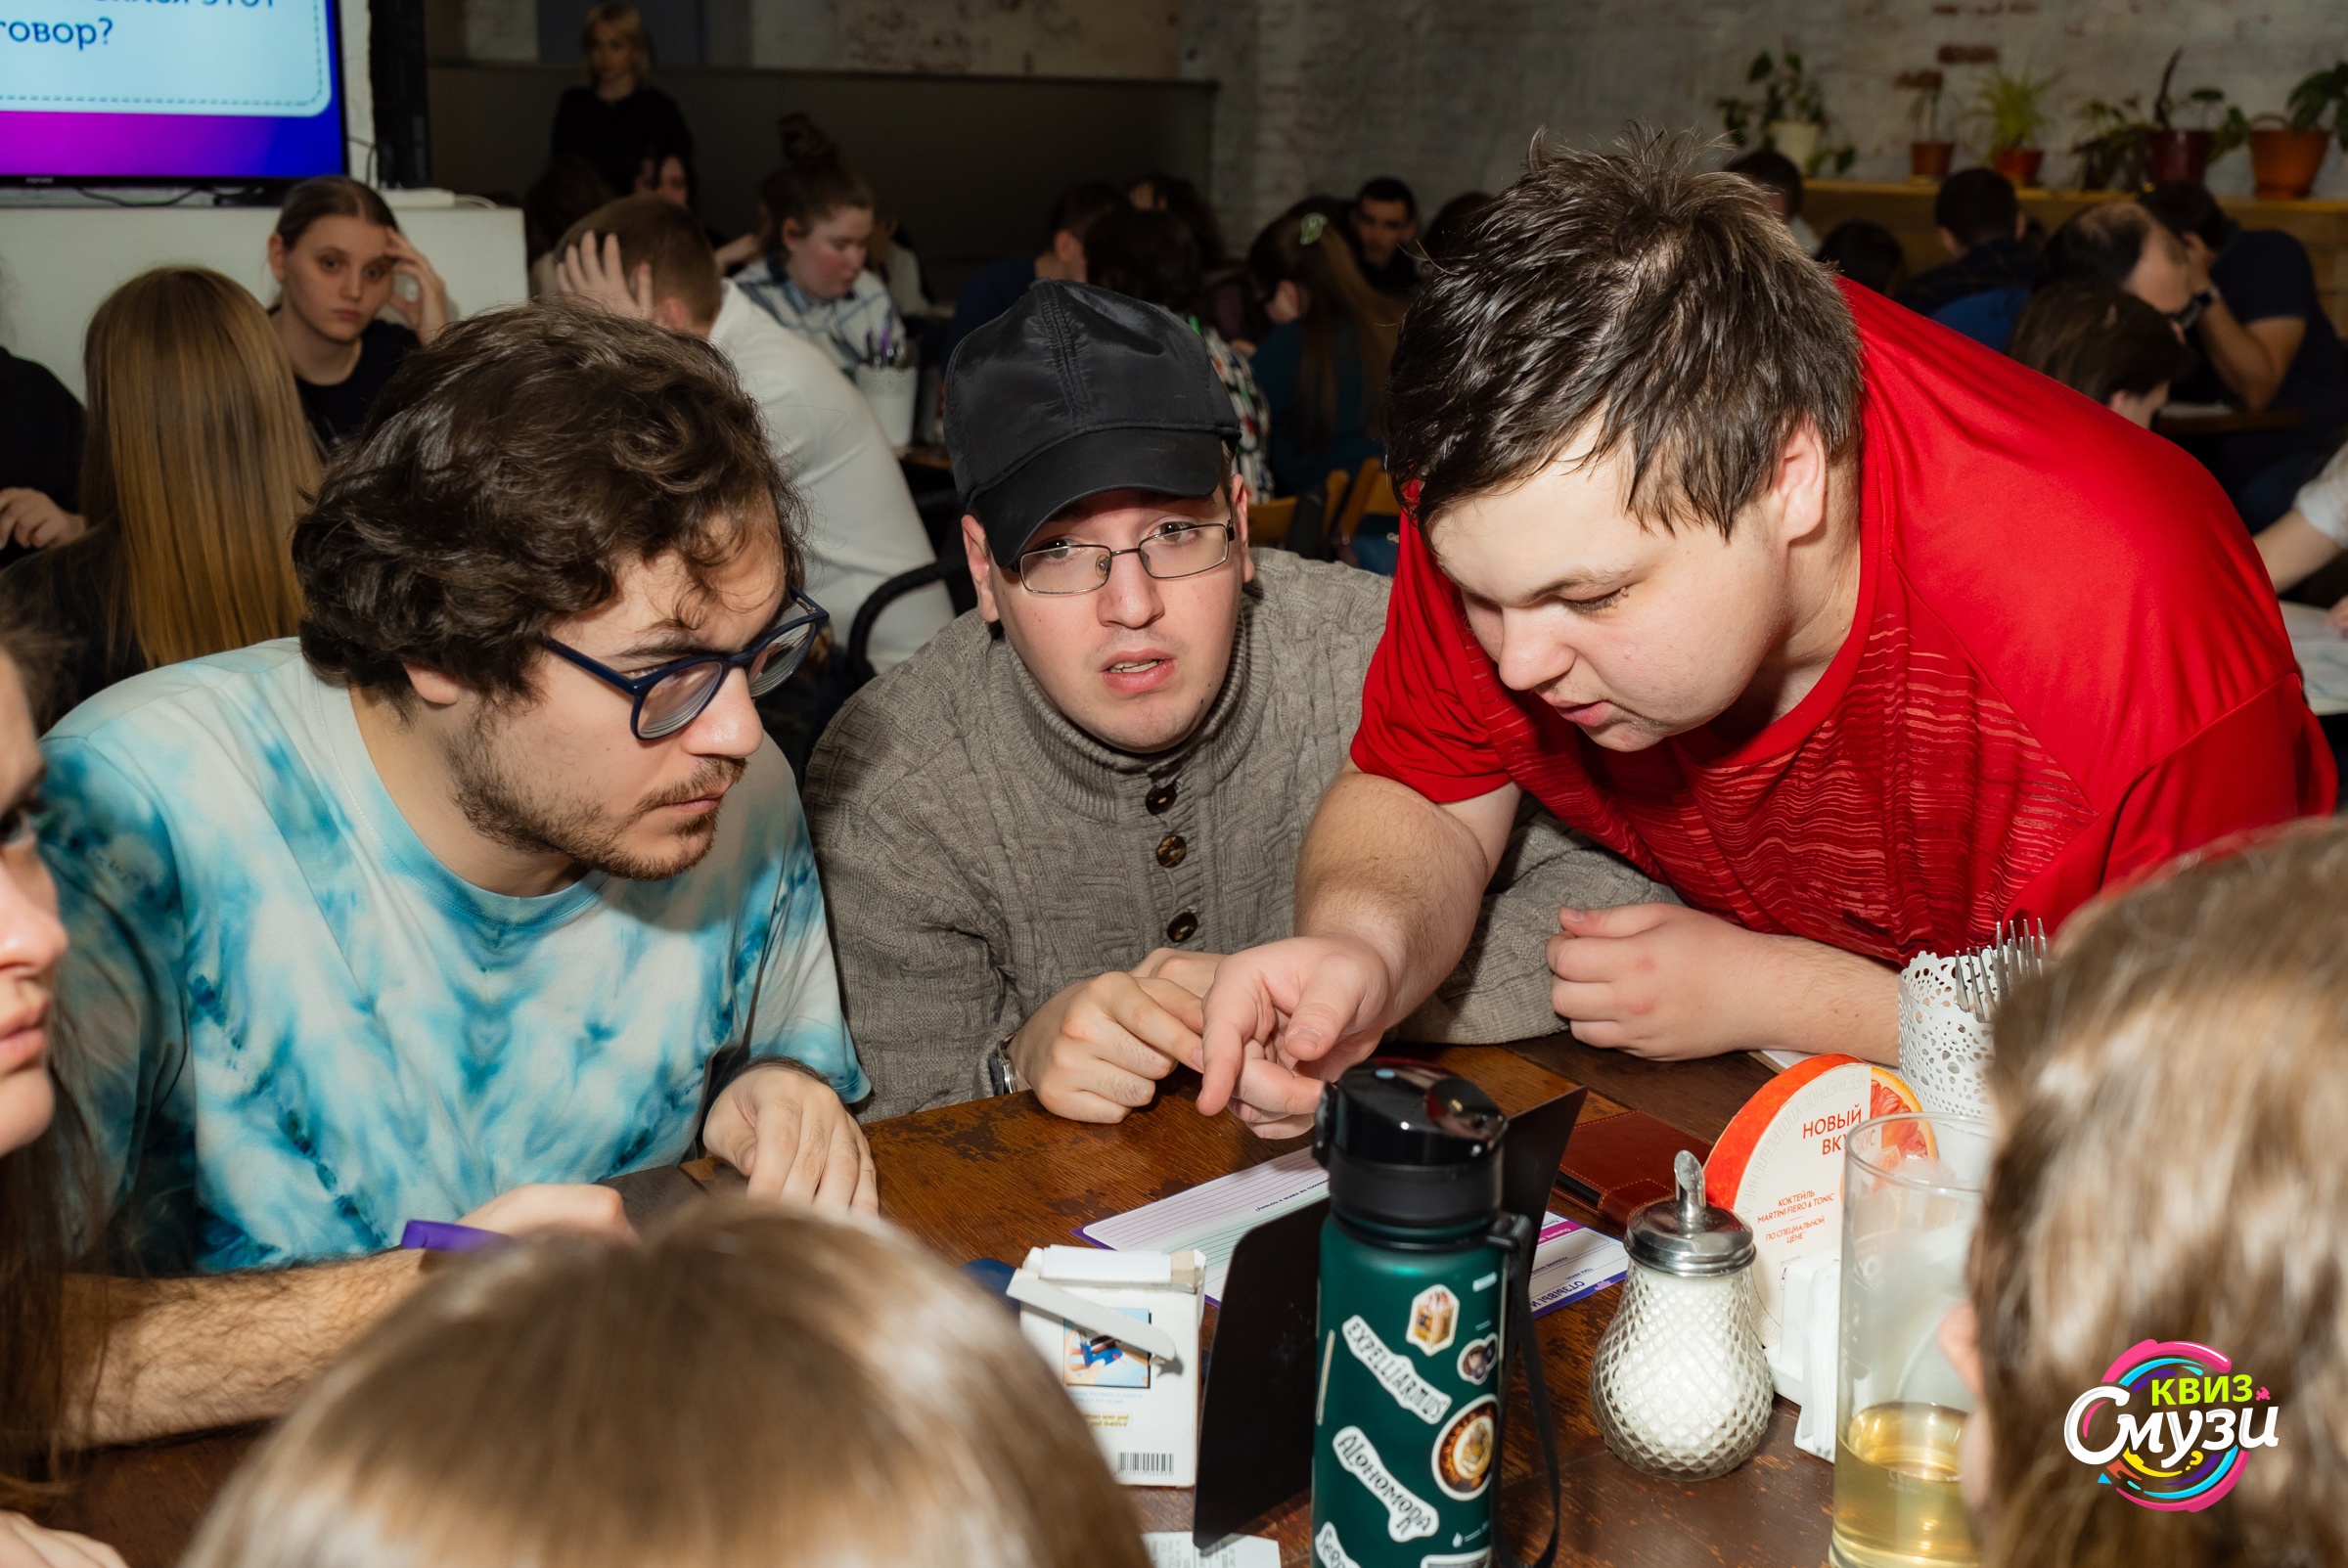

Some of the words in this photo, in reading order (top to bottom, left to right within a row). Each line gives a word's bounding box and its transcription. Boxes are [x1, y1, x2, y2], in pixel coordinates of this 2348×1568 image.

[0, 17, 113, 50] овор?
[1802, 1103, 1862, 1139] НОВЫЙ
[1778, 1189, 1815, 1207] КОКТЕЙЛЬ
[1758, 1208, 1786, 1224] MARTINI
[1786, 1201, 1807, 1214] FIERO
[1766, 1232, 1776, 1241] ПО
[1777, 1215, 1826, 1237] СПЕЦИАЛЬНОЙ
[1538, 1280, 1585, 1303] ОТЗЫВЫ
